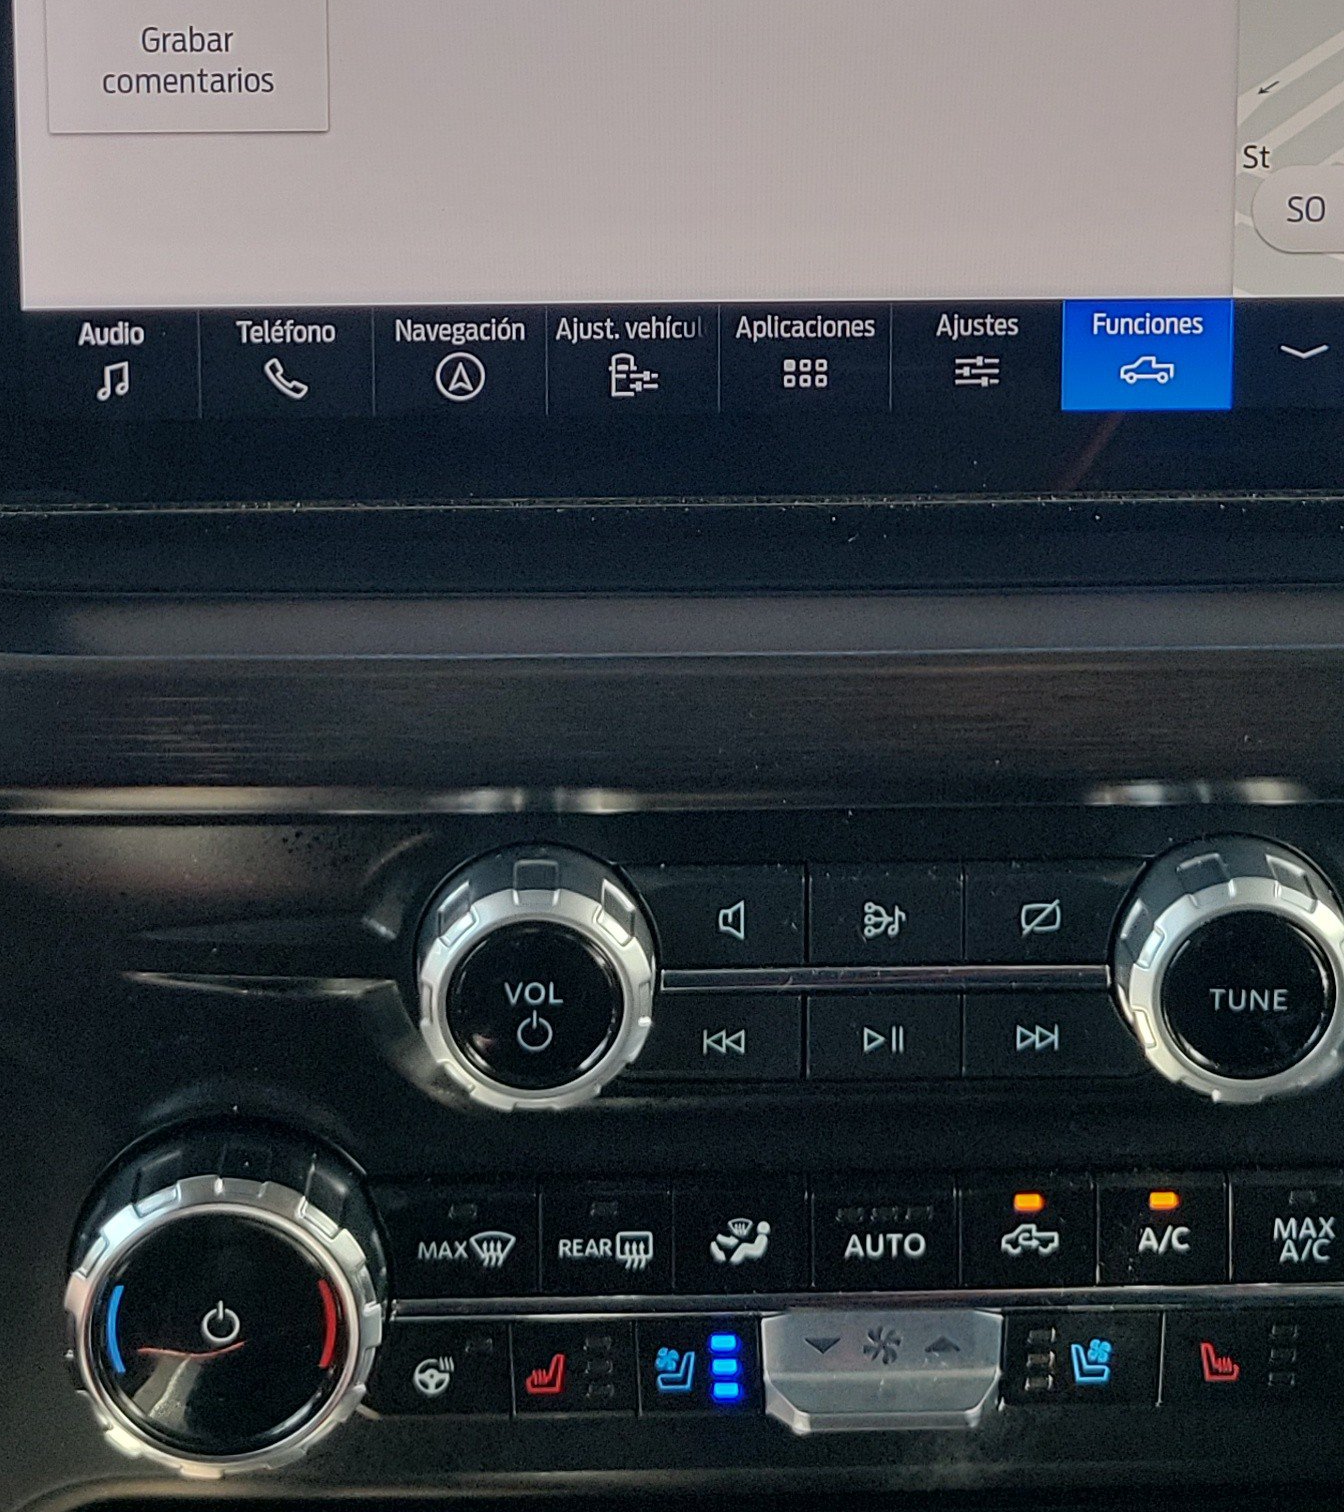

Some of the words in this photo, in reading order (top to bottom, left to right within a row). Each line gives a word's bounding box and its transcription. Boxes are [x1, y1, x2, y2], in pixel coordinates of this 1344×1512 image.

[142, 26, 233, 53] Grabar
[103, 67, 274, 94] comentarios
[1243, 145, 1270, 168] St
[1287, 195, 1326, 223] SO
[78, 321, 144, 346] Audio
[236, 319, 336, 345] Teléfono
[395, 317, 525, 346] Navegación
[556, 315, 620, 342] Ajust.
[736, 315, 875, 343] Aplicaciones
[936, 313, 1019, 341] Ajustes
[1092, 312, 1204, 337] Funciones
[504, 982, 564, 1008] VOL
[1210, 986, 1289, 1014] TUNE
[1138, 1225, 1191, 1255] A/C
[1274, 1216, 1336, 1240] MAX
[418, 1240, 468, 1260] MAX
[558, 1236, 613, 1259] REAR
[844, 1233, 926, 1260] AUTO
[1279, 1238, 1331, 1263] A/C
